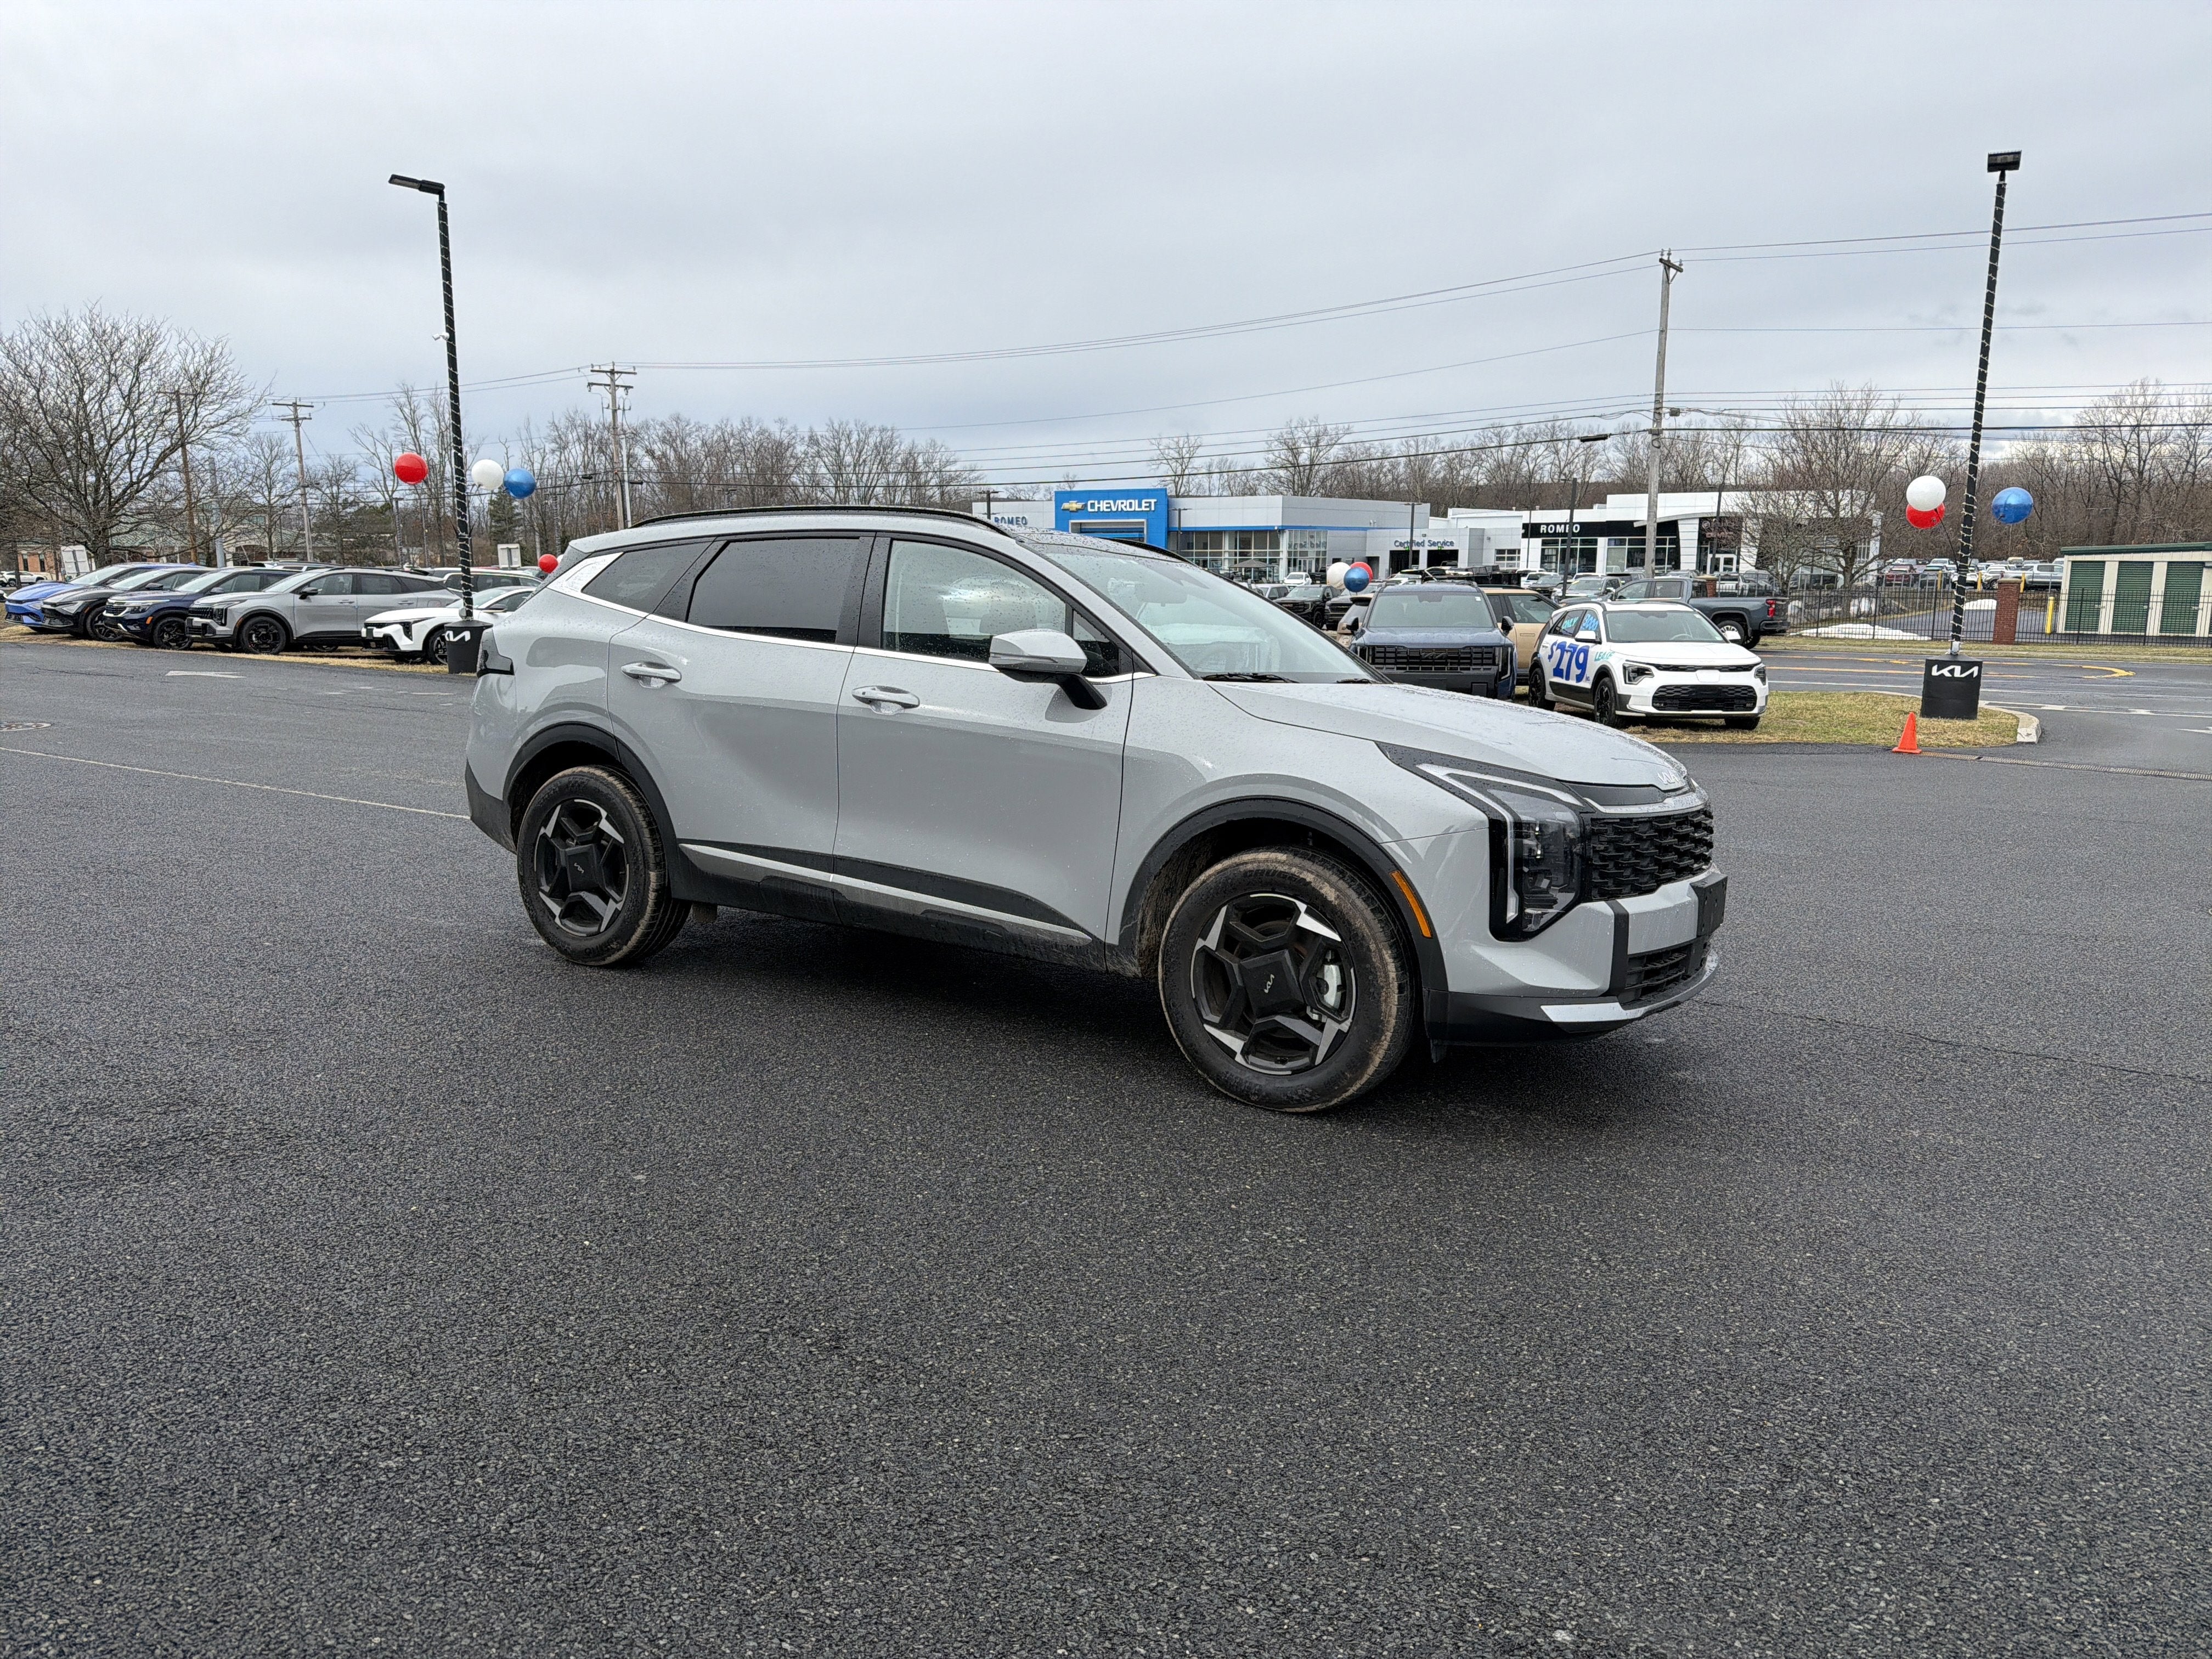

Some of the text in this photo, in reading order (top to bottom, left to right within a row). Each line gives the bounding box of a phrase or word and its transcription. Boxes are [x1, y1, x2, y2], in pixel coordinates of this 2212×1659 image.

[1087, 499, 1157, 512] CHEVROLET
[994, 516, 1028, 526] ROMEO
[1394, 539, 1425, 548] Certied
[1548, 640, 1590, 684] $279
[1931, 664, 1979, 678] KIA
